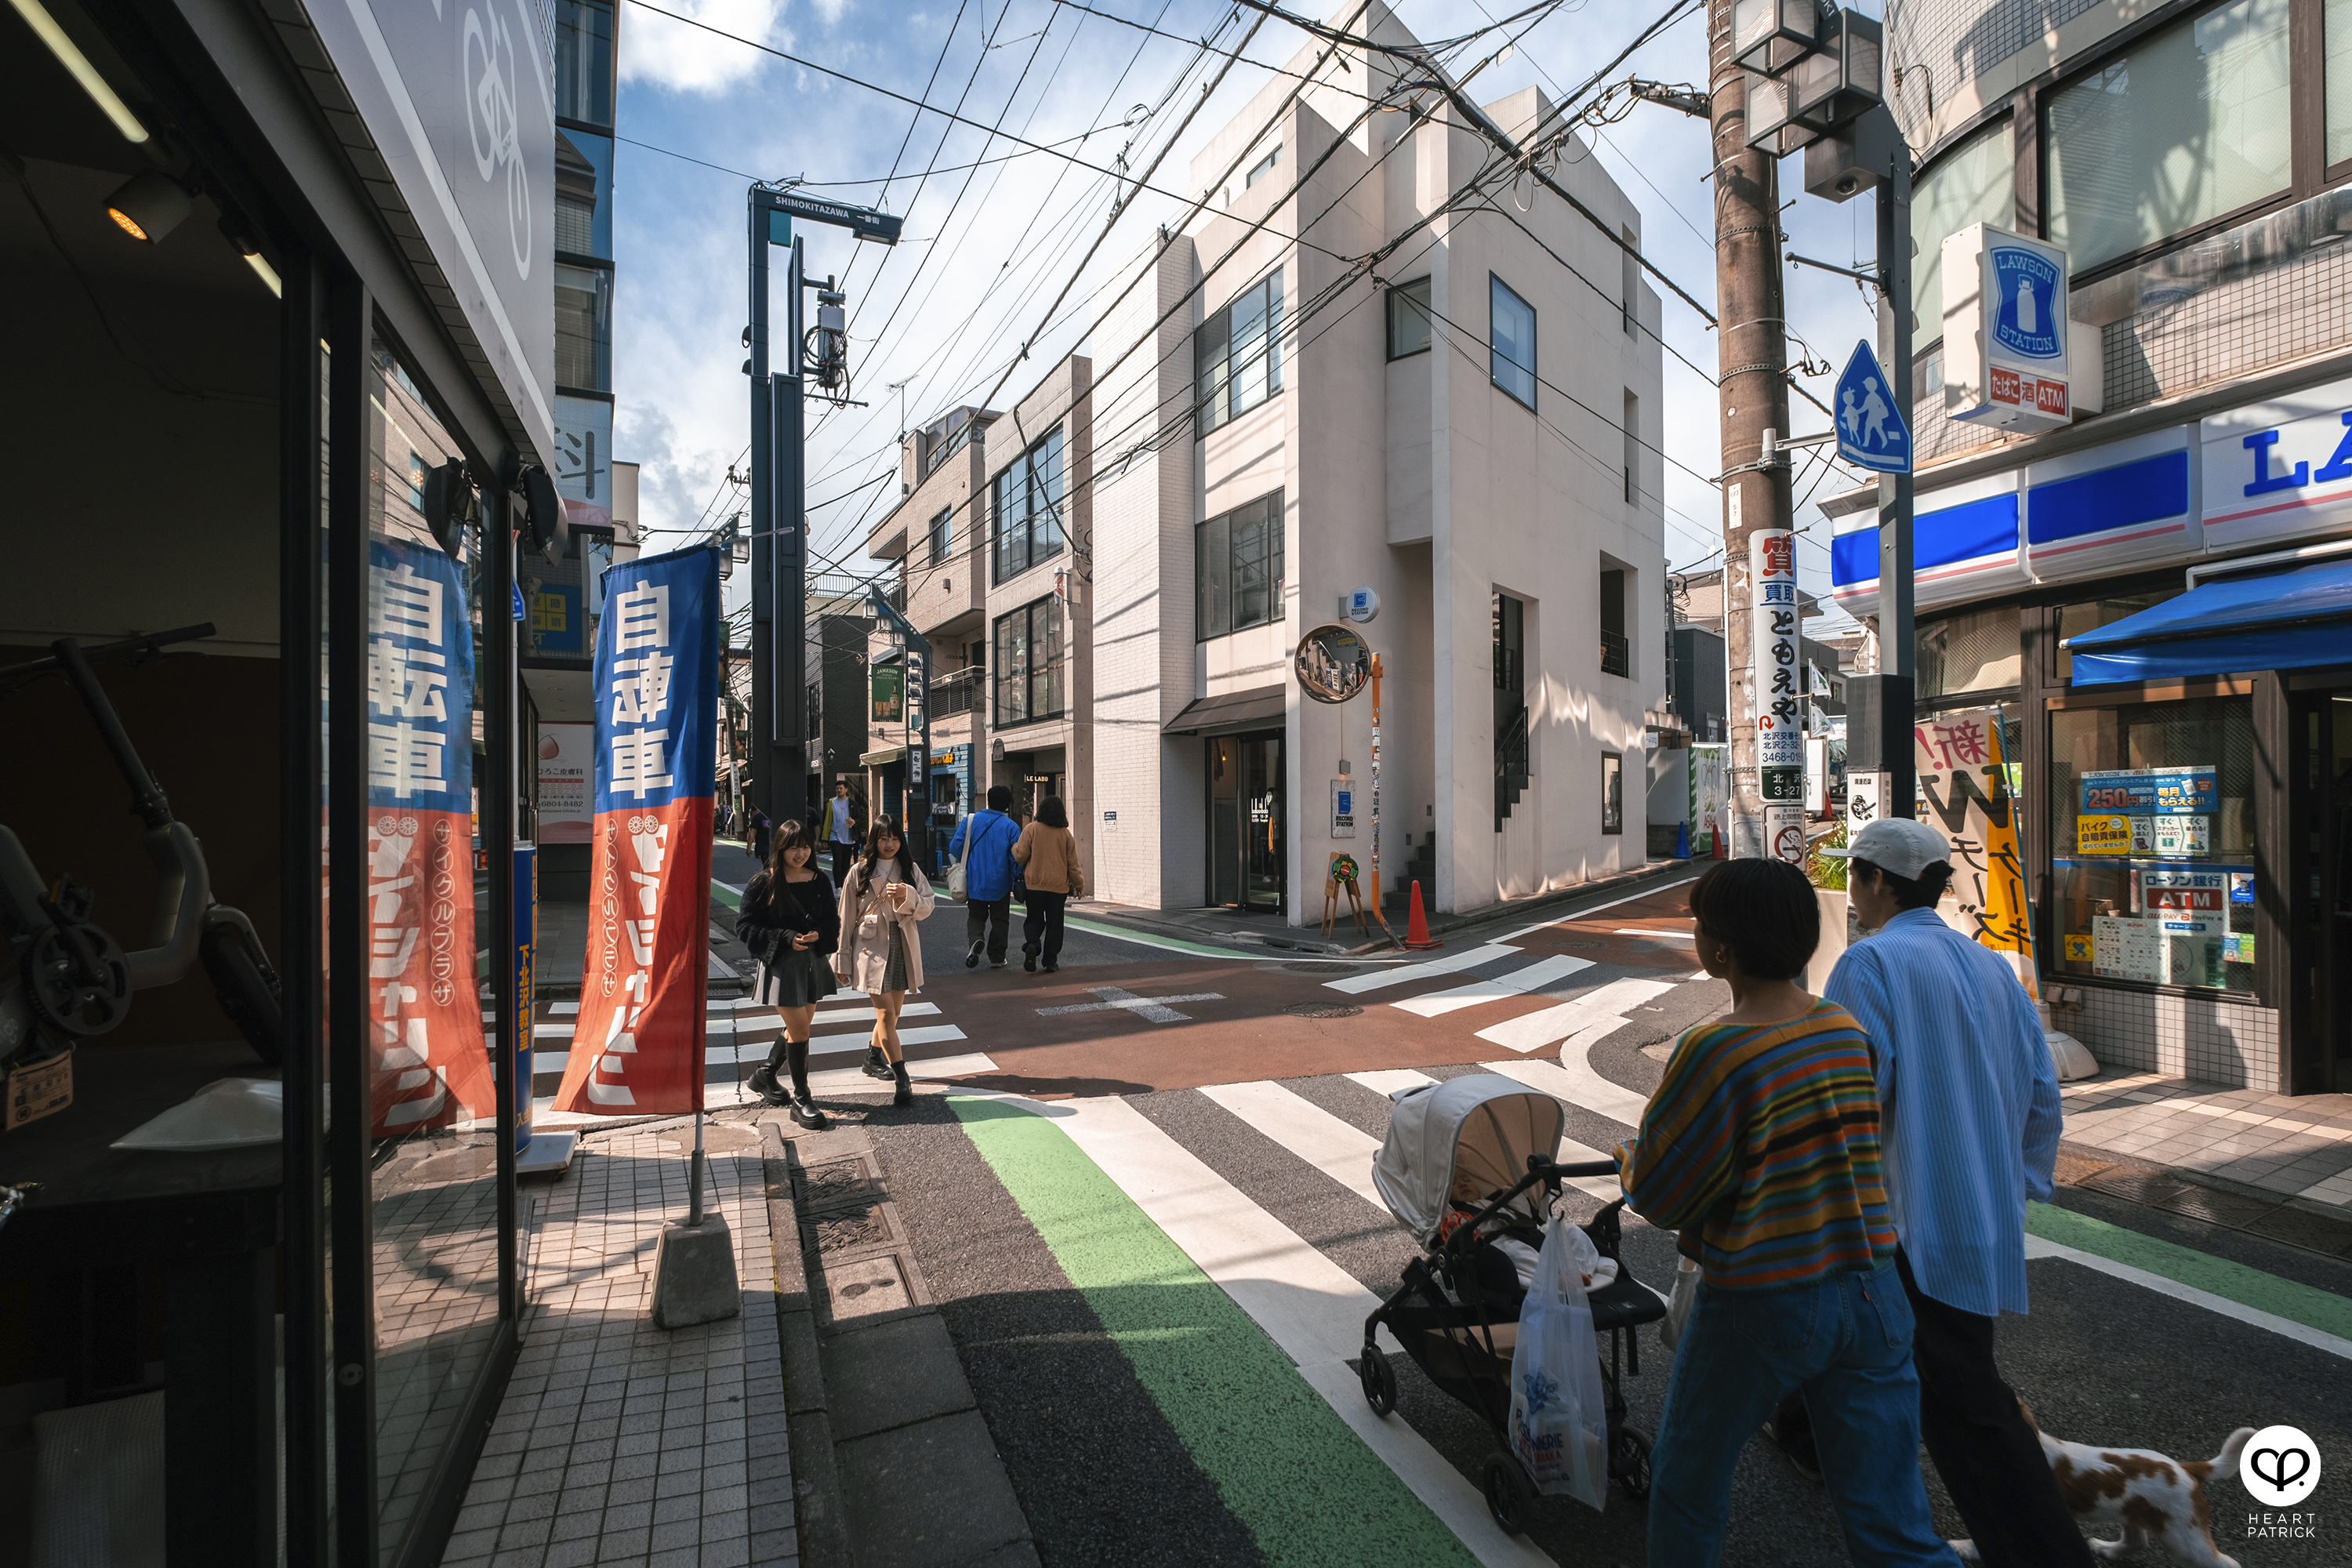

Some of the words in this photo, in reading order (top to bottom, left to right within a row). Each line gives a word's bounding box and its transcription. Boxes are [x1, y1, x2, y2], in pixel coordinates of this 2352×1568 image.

[775, 196, 850, 219] SHIMOKITAZAWA
[1998, 255, 2053, 284] LAWSON
[2000, 324, 2054, 351] STATION
[1992, 374, 2020, 399] たばこ
[2021, 381, 2035, 403] 酒
[2038, 386, 2064, 409] ATM
[1762, 535, 1794, 577] 質
[1765, 584, 1795, 602] 買取
[1770, 610, 1798, 725] ともえや
[368, 561, 448, 799] 自転車
[1762, 741, 1802, 750] 北沢2-32-
[1774, 786, 1801, 795] 3-27
[2158, 786, 2180, 797] 毎月
[2081, 822, 2108, 832] バイク
[2082, 830, 2128, 842] 自賠責保険
[2145, 875, 2222, 887] ローソン銀行
[2158, 891, 2210, 907] ATM
[430, 818, 456, 1007] サイクルプラザ
[518, 943, 530, 1052] 下北沢教室
